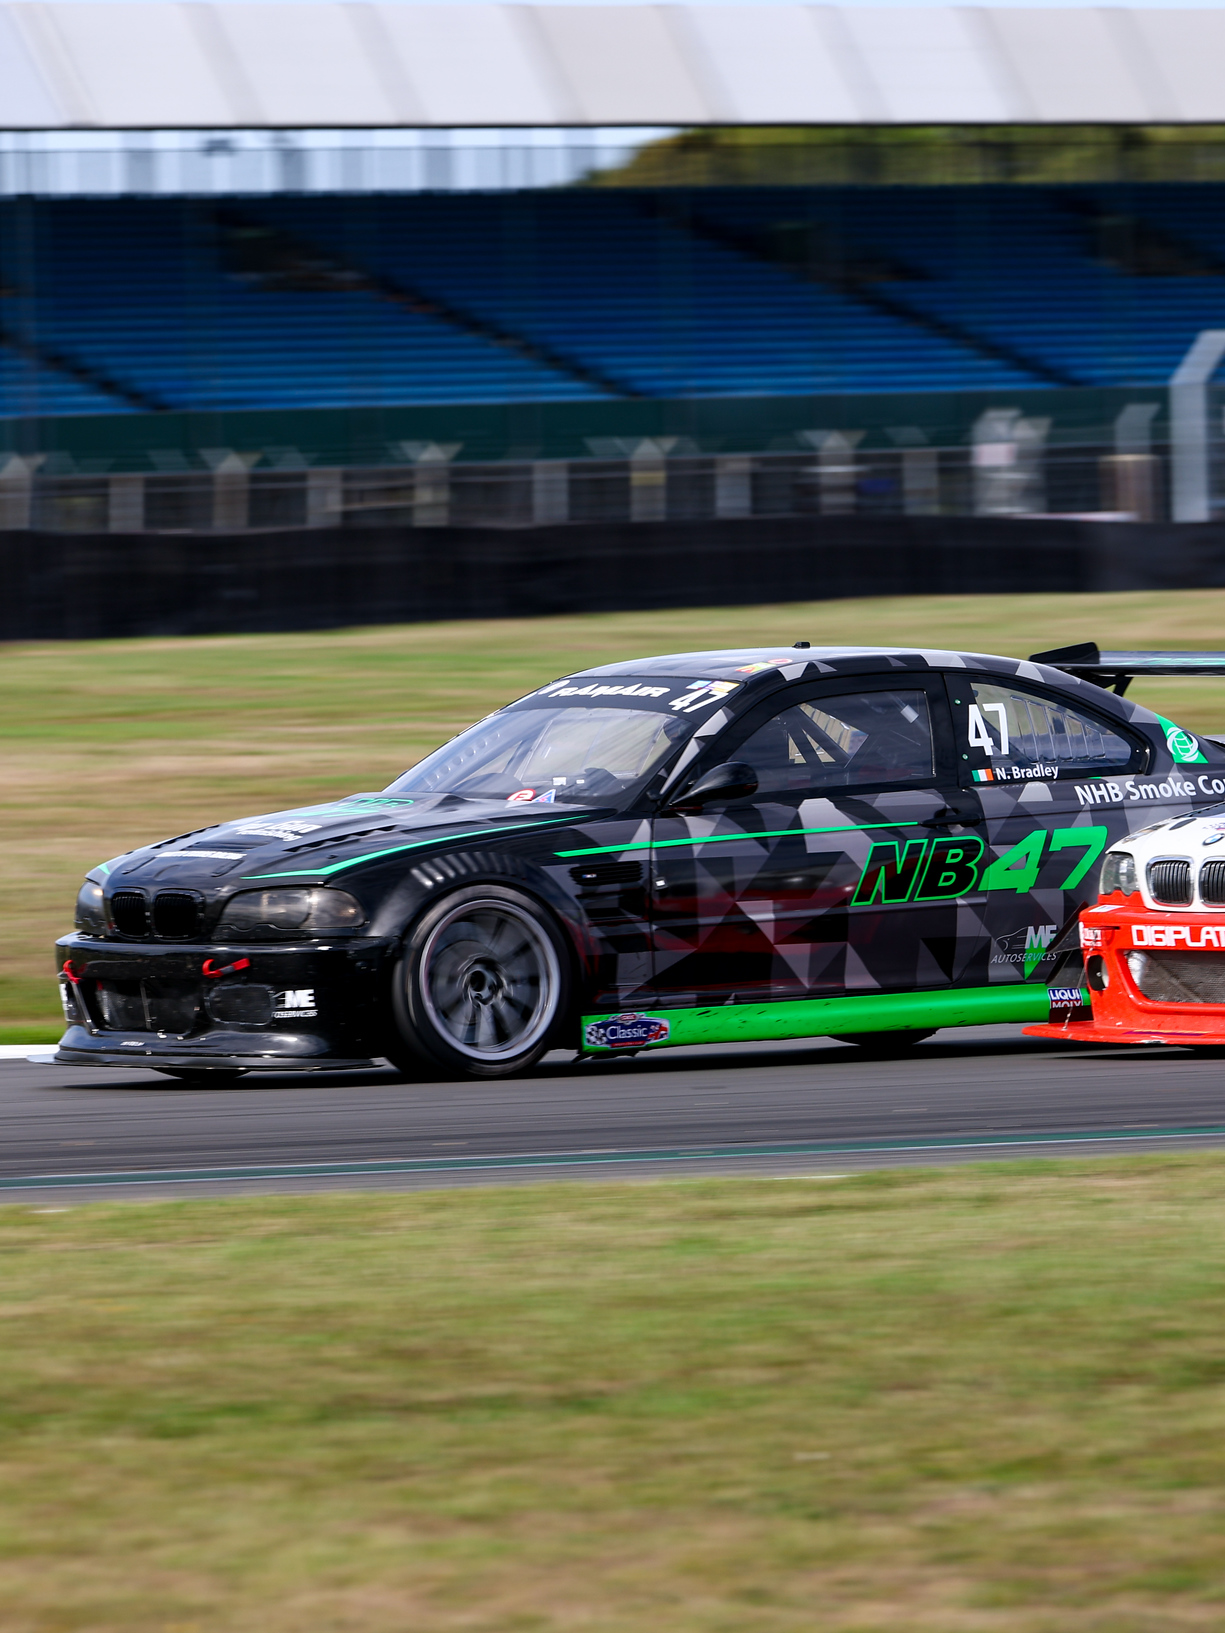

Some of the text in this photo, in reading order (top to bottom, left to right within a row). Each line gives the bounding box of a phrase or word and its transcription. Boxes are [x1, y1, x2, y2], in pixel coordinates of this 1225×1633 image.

[548, 682, 671, 698] RAMAIR
[668, 688, 729, 713] 47
[967, 702, 1010, 756] 47
[995, 764, 1059, 780] N. Bradley
[1073, 782, 1124, 806] NHB
[1125, 776, 1197, 801] Smoke
[990, 952, 1057, 964] AUTOSERVICES
[1048, 988, 1081, 1001] LIQUI
[605, 1024, 648, 1040] Classic
